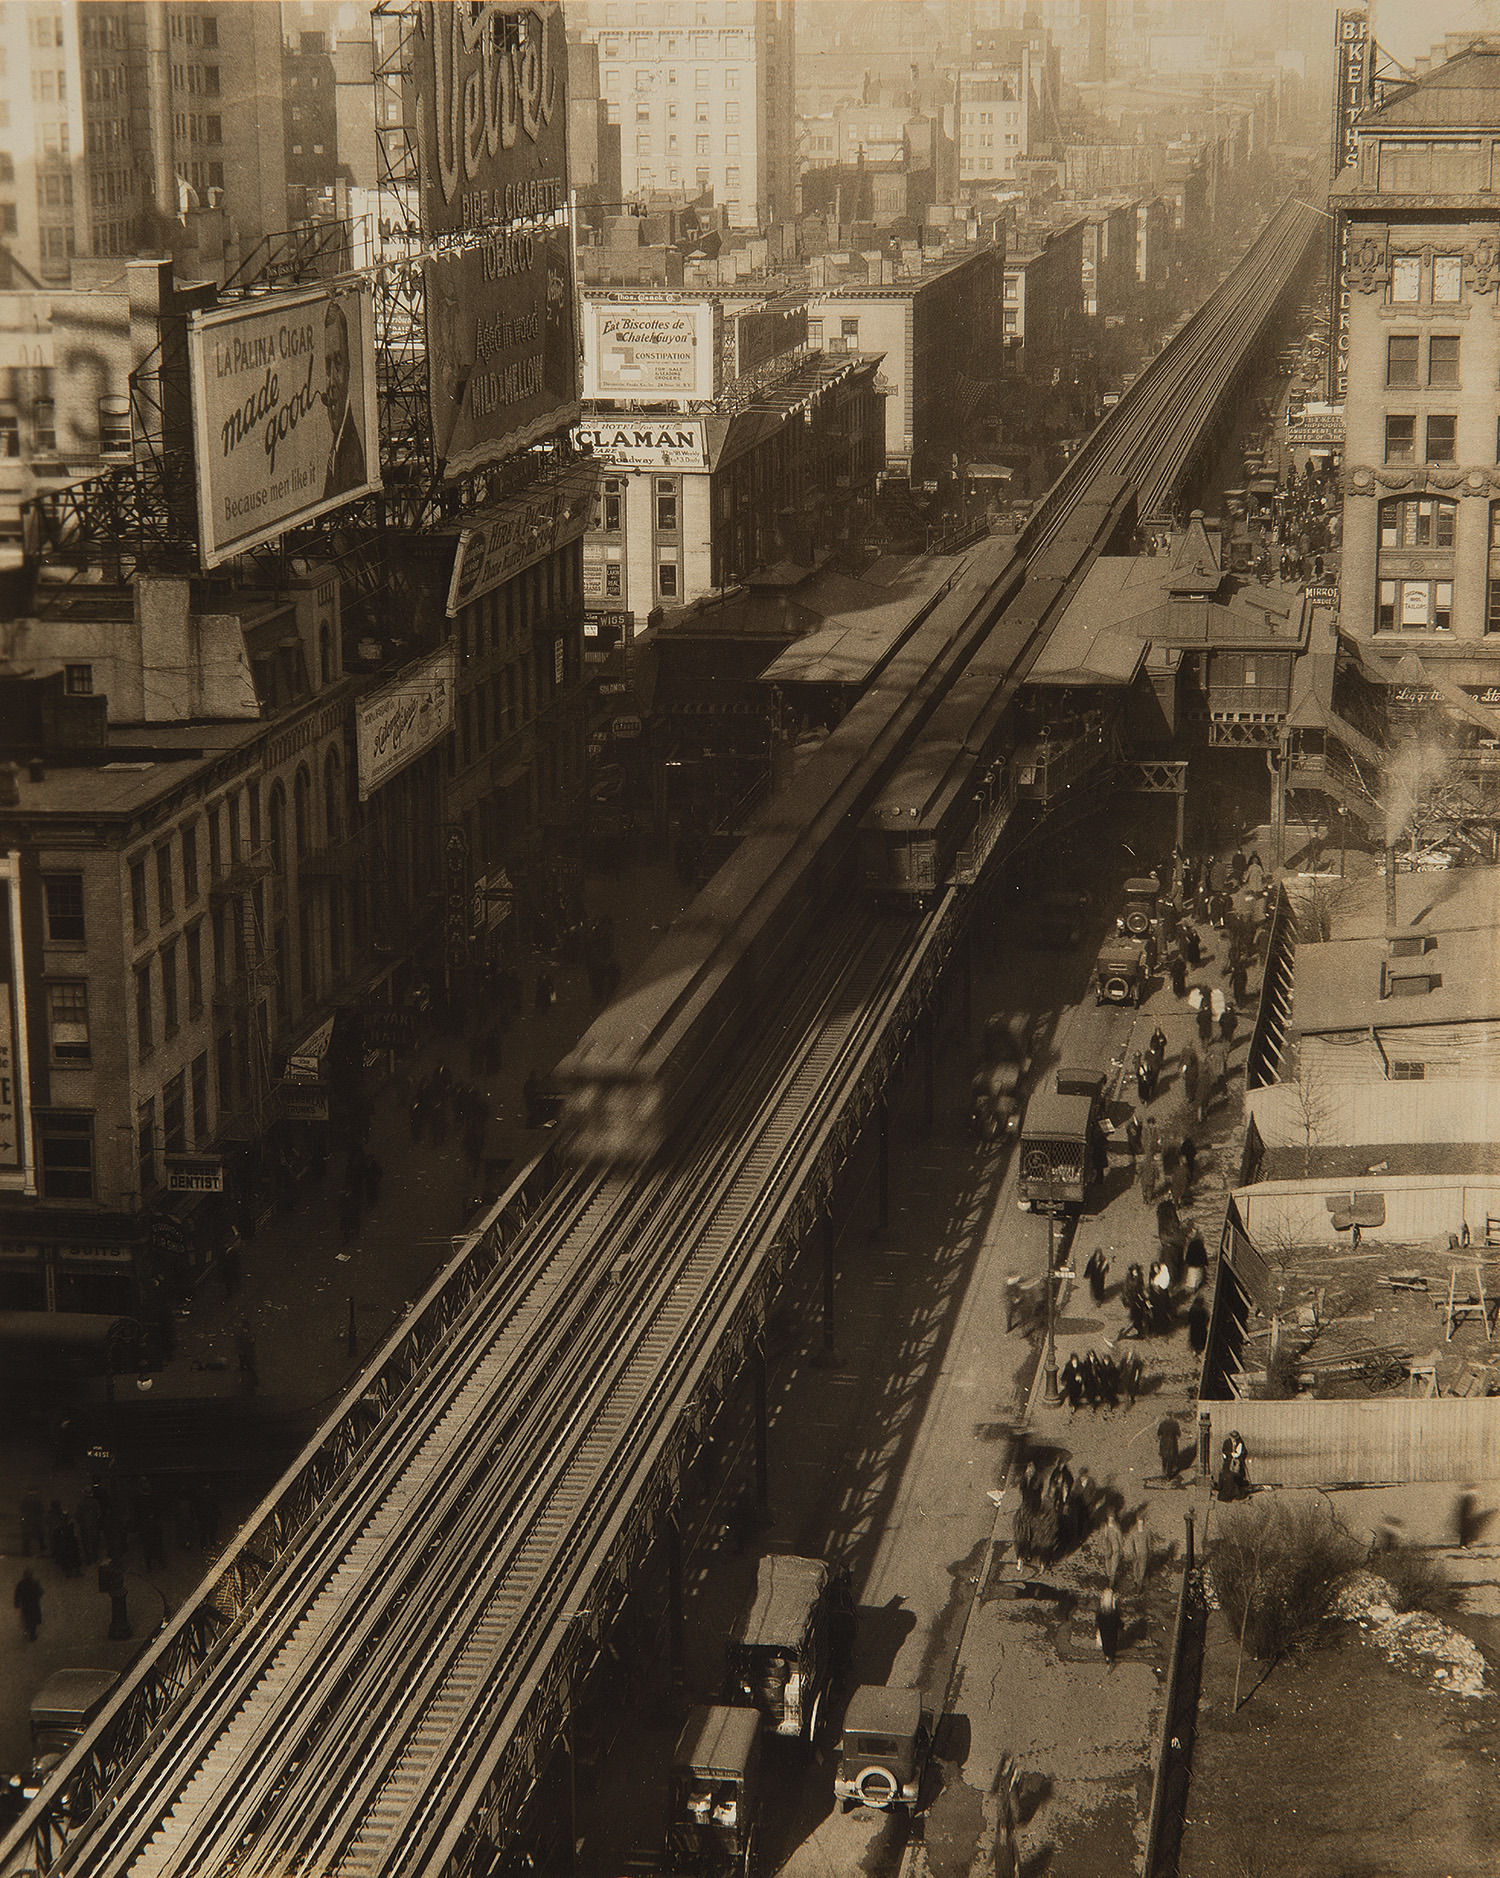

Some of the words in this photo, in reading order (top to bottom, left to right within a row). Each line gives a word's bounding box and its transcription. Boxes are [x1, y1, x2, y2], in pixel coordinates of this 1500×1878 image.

[462, 190, 489, 229] PIPE
[505, 177, 561, 219] CIGARETTE
[481, 232, 534, 283] TOBACCO
[234, 334, 276, 370] PALINA
[279, 325, 315, 359] CIGAR
[602, 320, 620, 336] Eat
[672, 319, 685, 330] de
[221, 367, 280, 457] made
[471, 371, 498, 419] MILD
[504, 354, 544, 406] MELLOW
[265, 354, 320, 475] good
[575, 431, 694, 448] CLAMAN
[223, 488, 268, 521] Because
[270, 479, 290, 498] men
[291, 468, 309, 491] like
[309, 461, 316, 484] it
[600, 615, 625, 626] WIGS
[446, 833, 467, 964] AUTOMAT
[287, 1106, 316, 1114] TRUNKS
[170, 1175, 219, 1189] DENTIST
